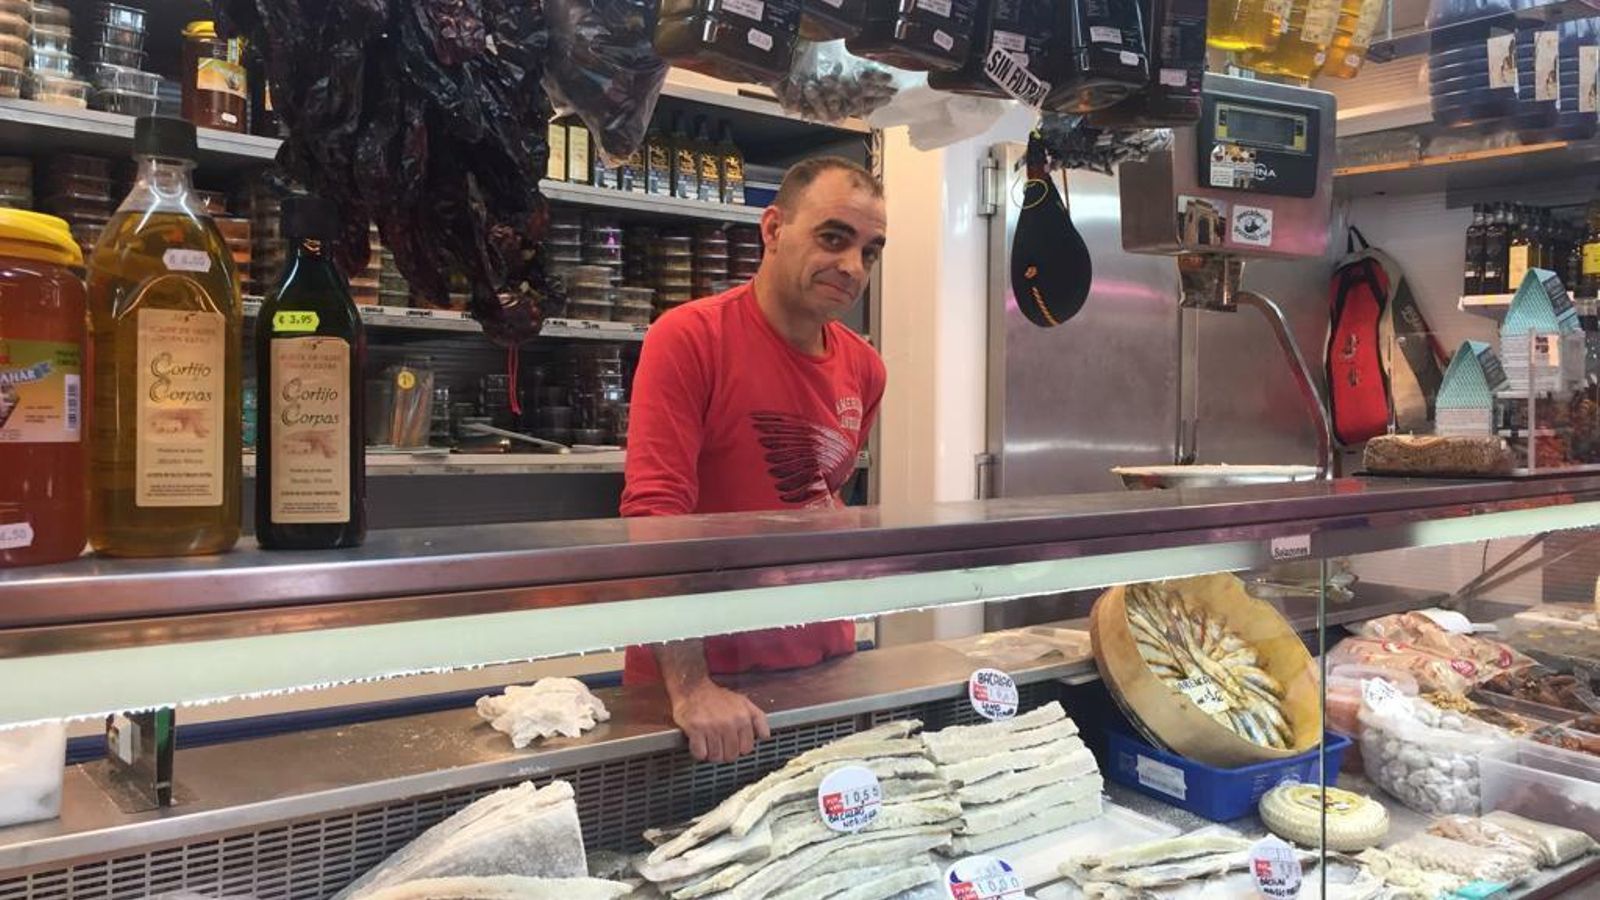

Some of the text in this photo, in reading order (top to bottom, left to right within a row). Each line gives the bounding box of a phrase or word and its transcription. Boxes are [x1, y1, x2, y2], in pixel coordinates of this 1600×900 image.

[988, 50, 1014, 81] SIN
[278, 314, 313, 324] € 3.95
[150, 352, 212, 380] Cortijo
[149, 377, 213, 406] Corpas
[281, 378, 339, 405] Cortijo
[280, 402, 341, 428] Corpas
